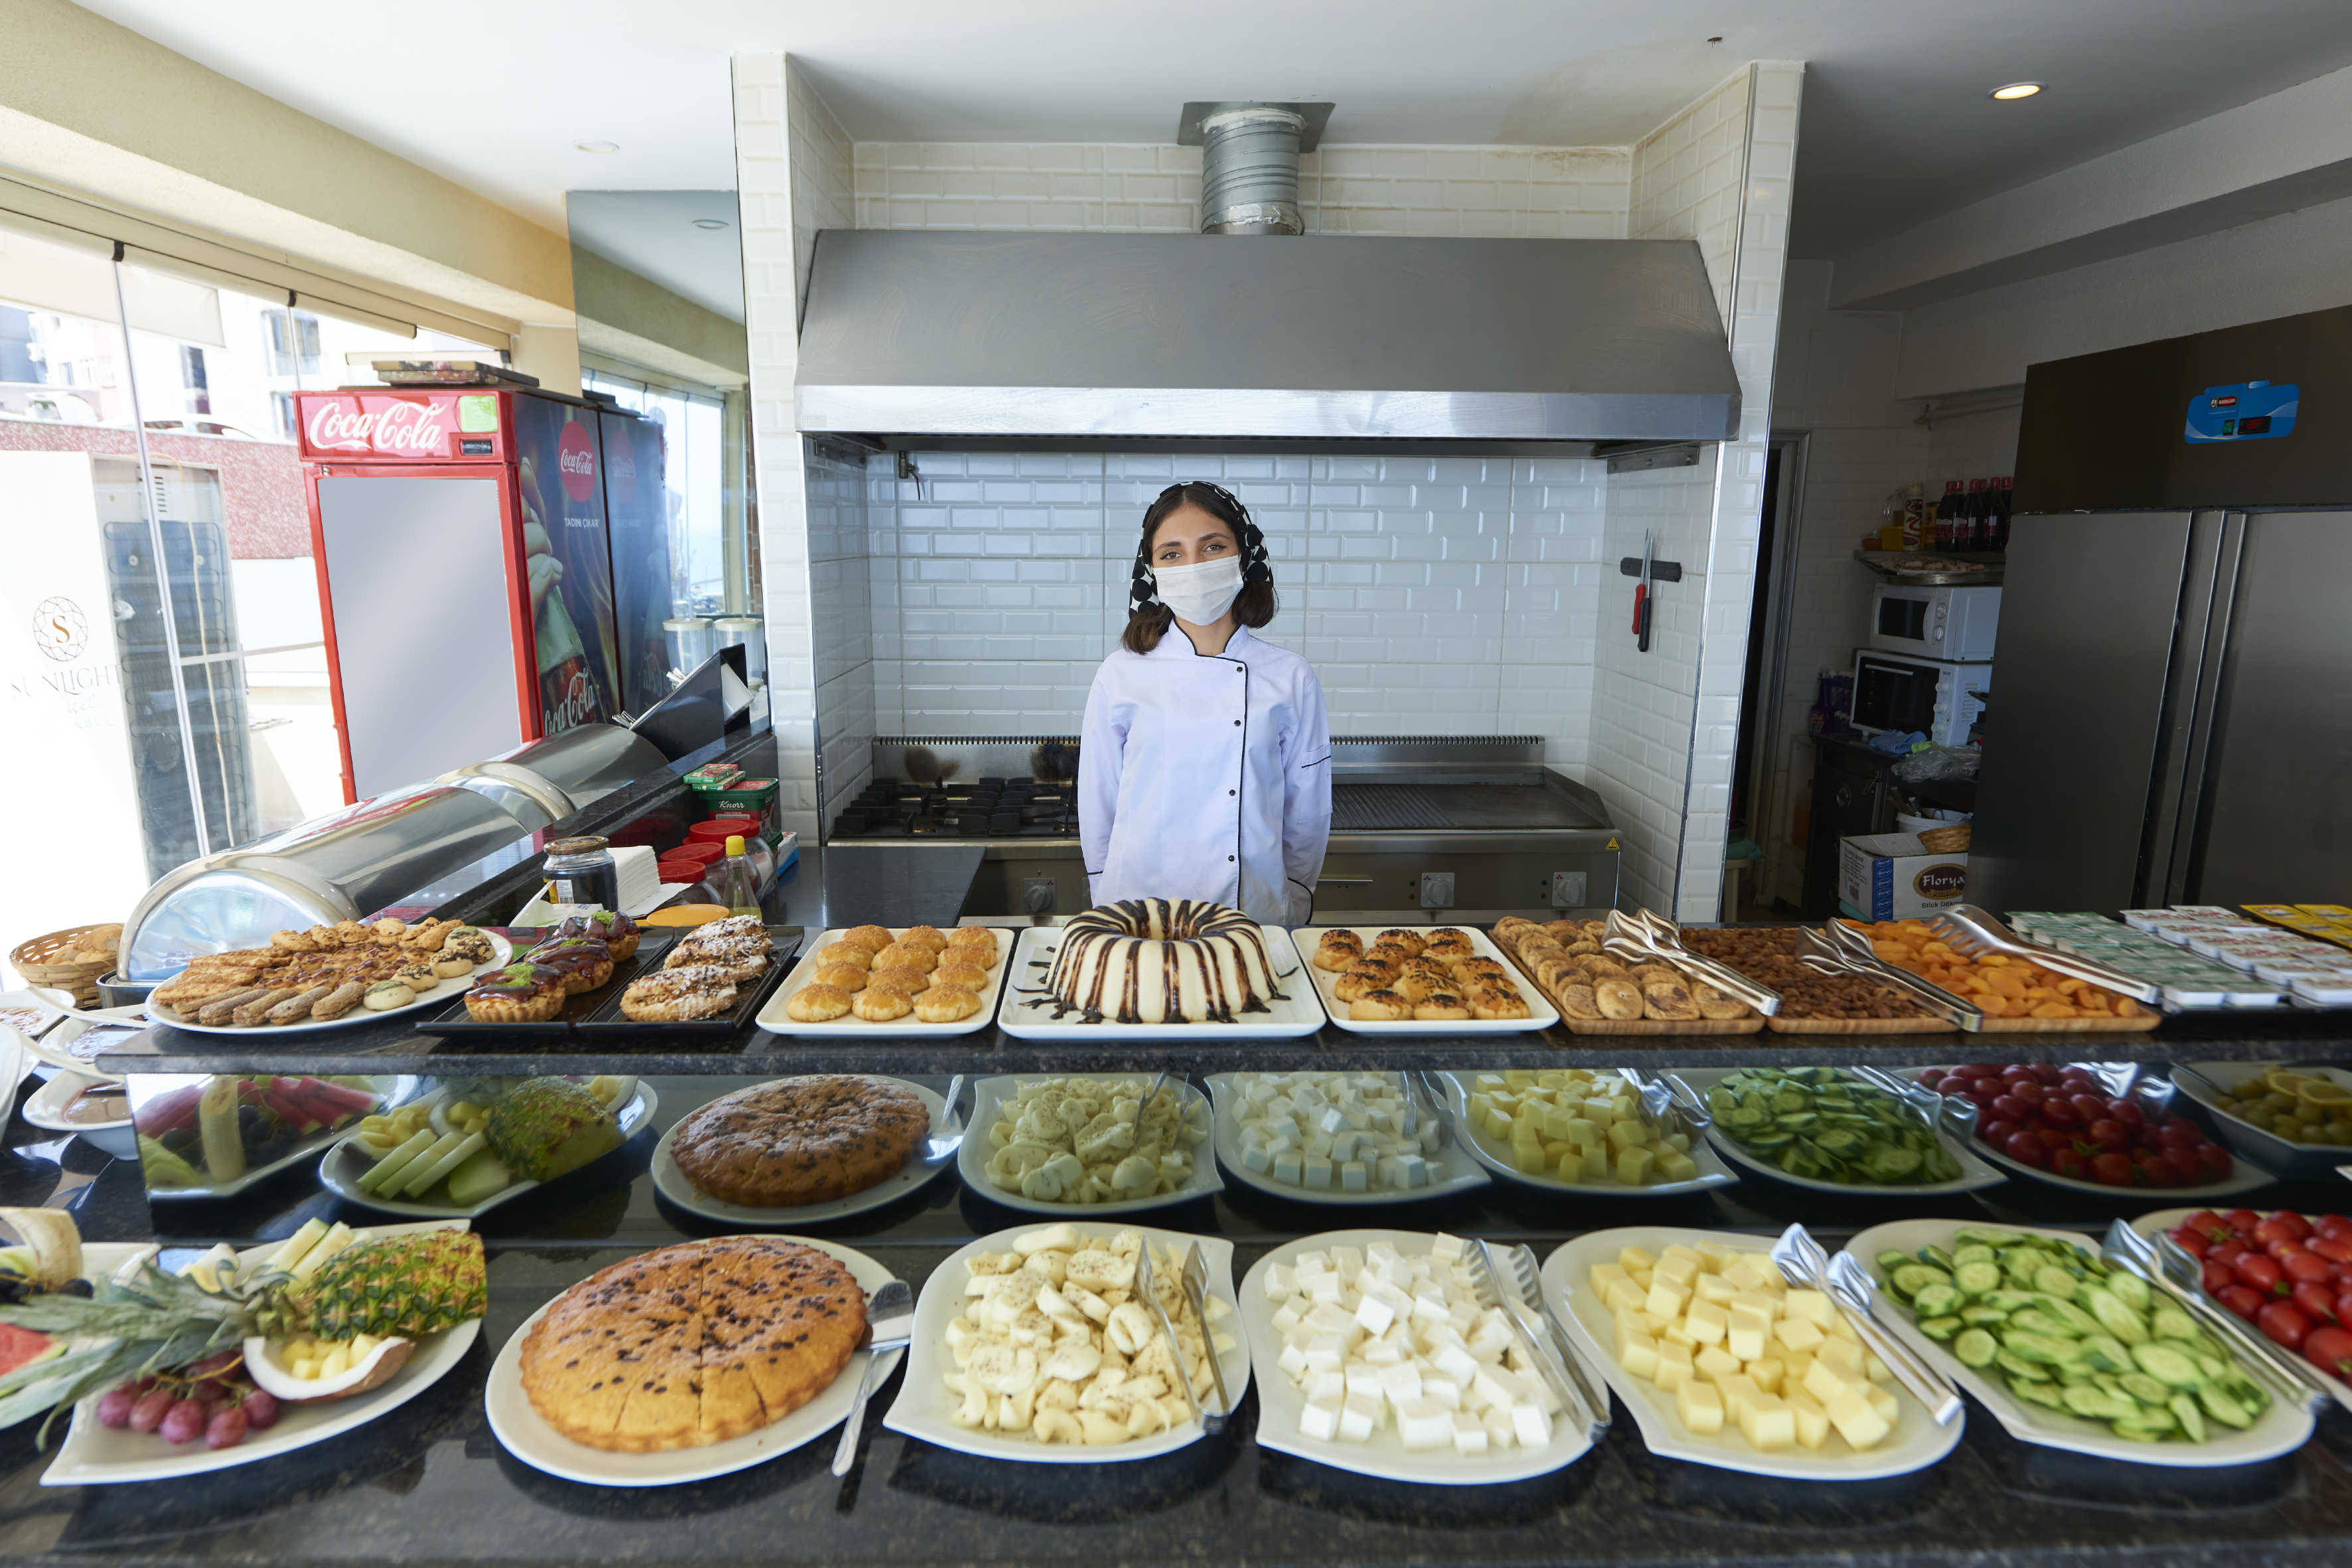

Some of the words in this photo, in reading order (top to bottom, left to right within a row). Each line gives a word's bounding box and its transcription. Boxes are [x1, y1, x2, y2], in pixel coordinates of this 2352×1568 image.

[309, 402, 447, 450] Coca-Cola
[560, 448, 593, 475] Coca-Cola
[564, 518, 582, 527] TADINI
[582, 518, 598, 528] ÇIKAR
[52, 615, 70, 643] S
[11, 664, 121, 700] SUNLIGHT
[718, 800, 745, 809] Knorr
[1922, 874, 1965, 887] Florya
